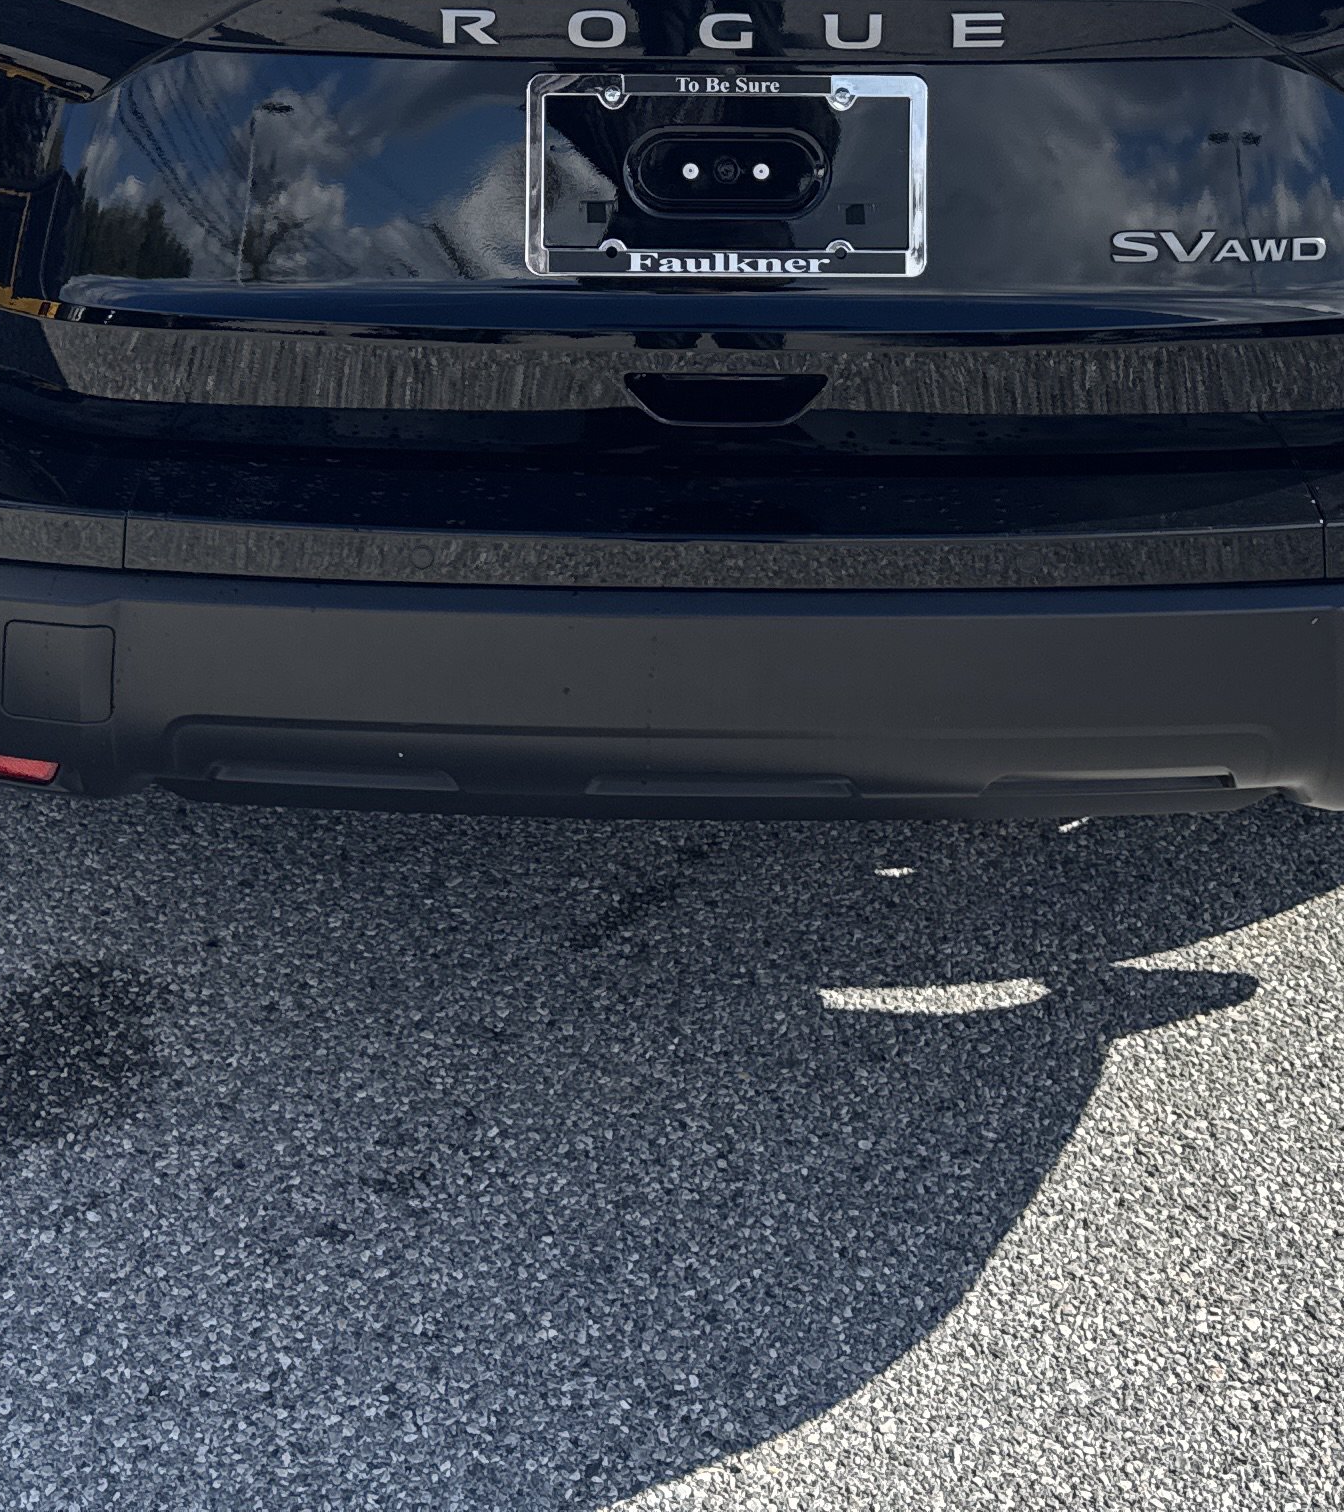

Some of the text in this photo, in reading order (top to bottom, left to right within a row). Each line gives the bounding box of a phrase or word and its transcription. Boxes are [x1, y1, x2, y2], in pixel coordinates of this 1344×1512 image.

[440, 8, 1006, 50] ROGUE
[675, 76, 781, 93] To Be Sure
[1112, 230, 1327, 263] SV AWD
[626, 251, 831, 274] Faulkner
